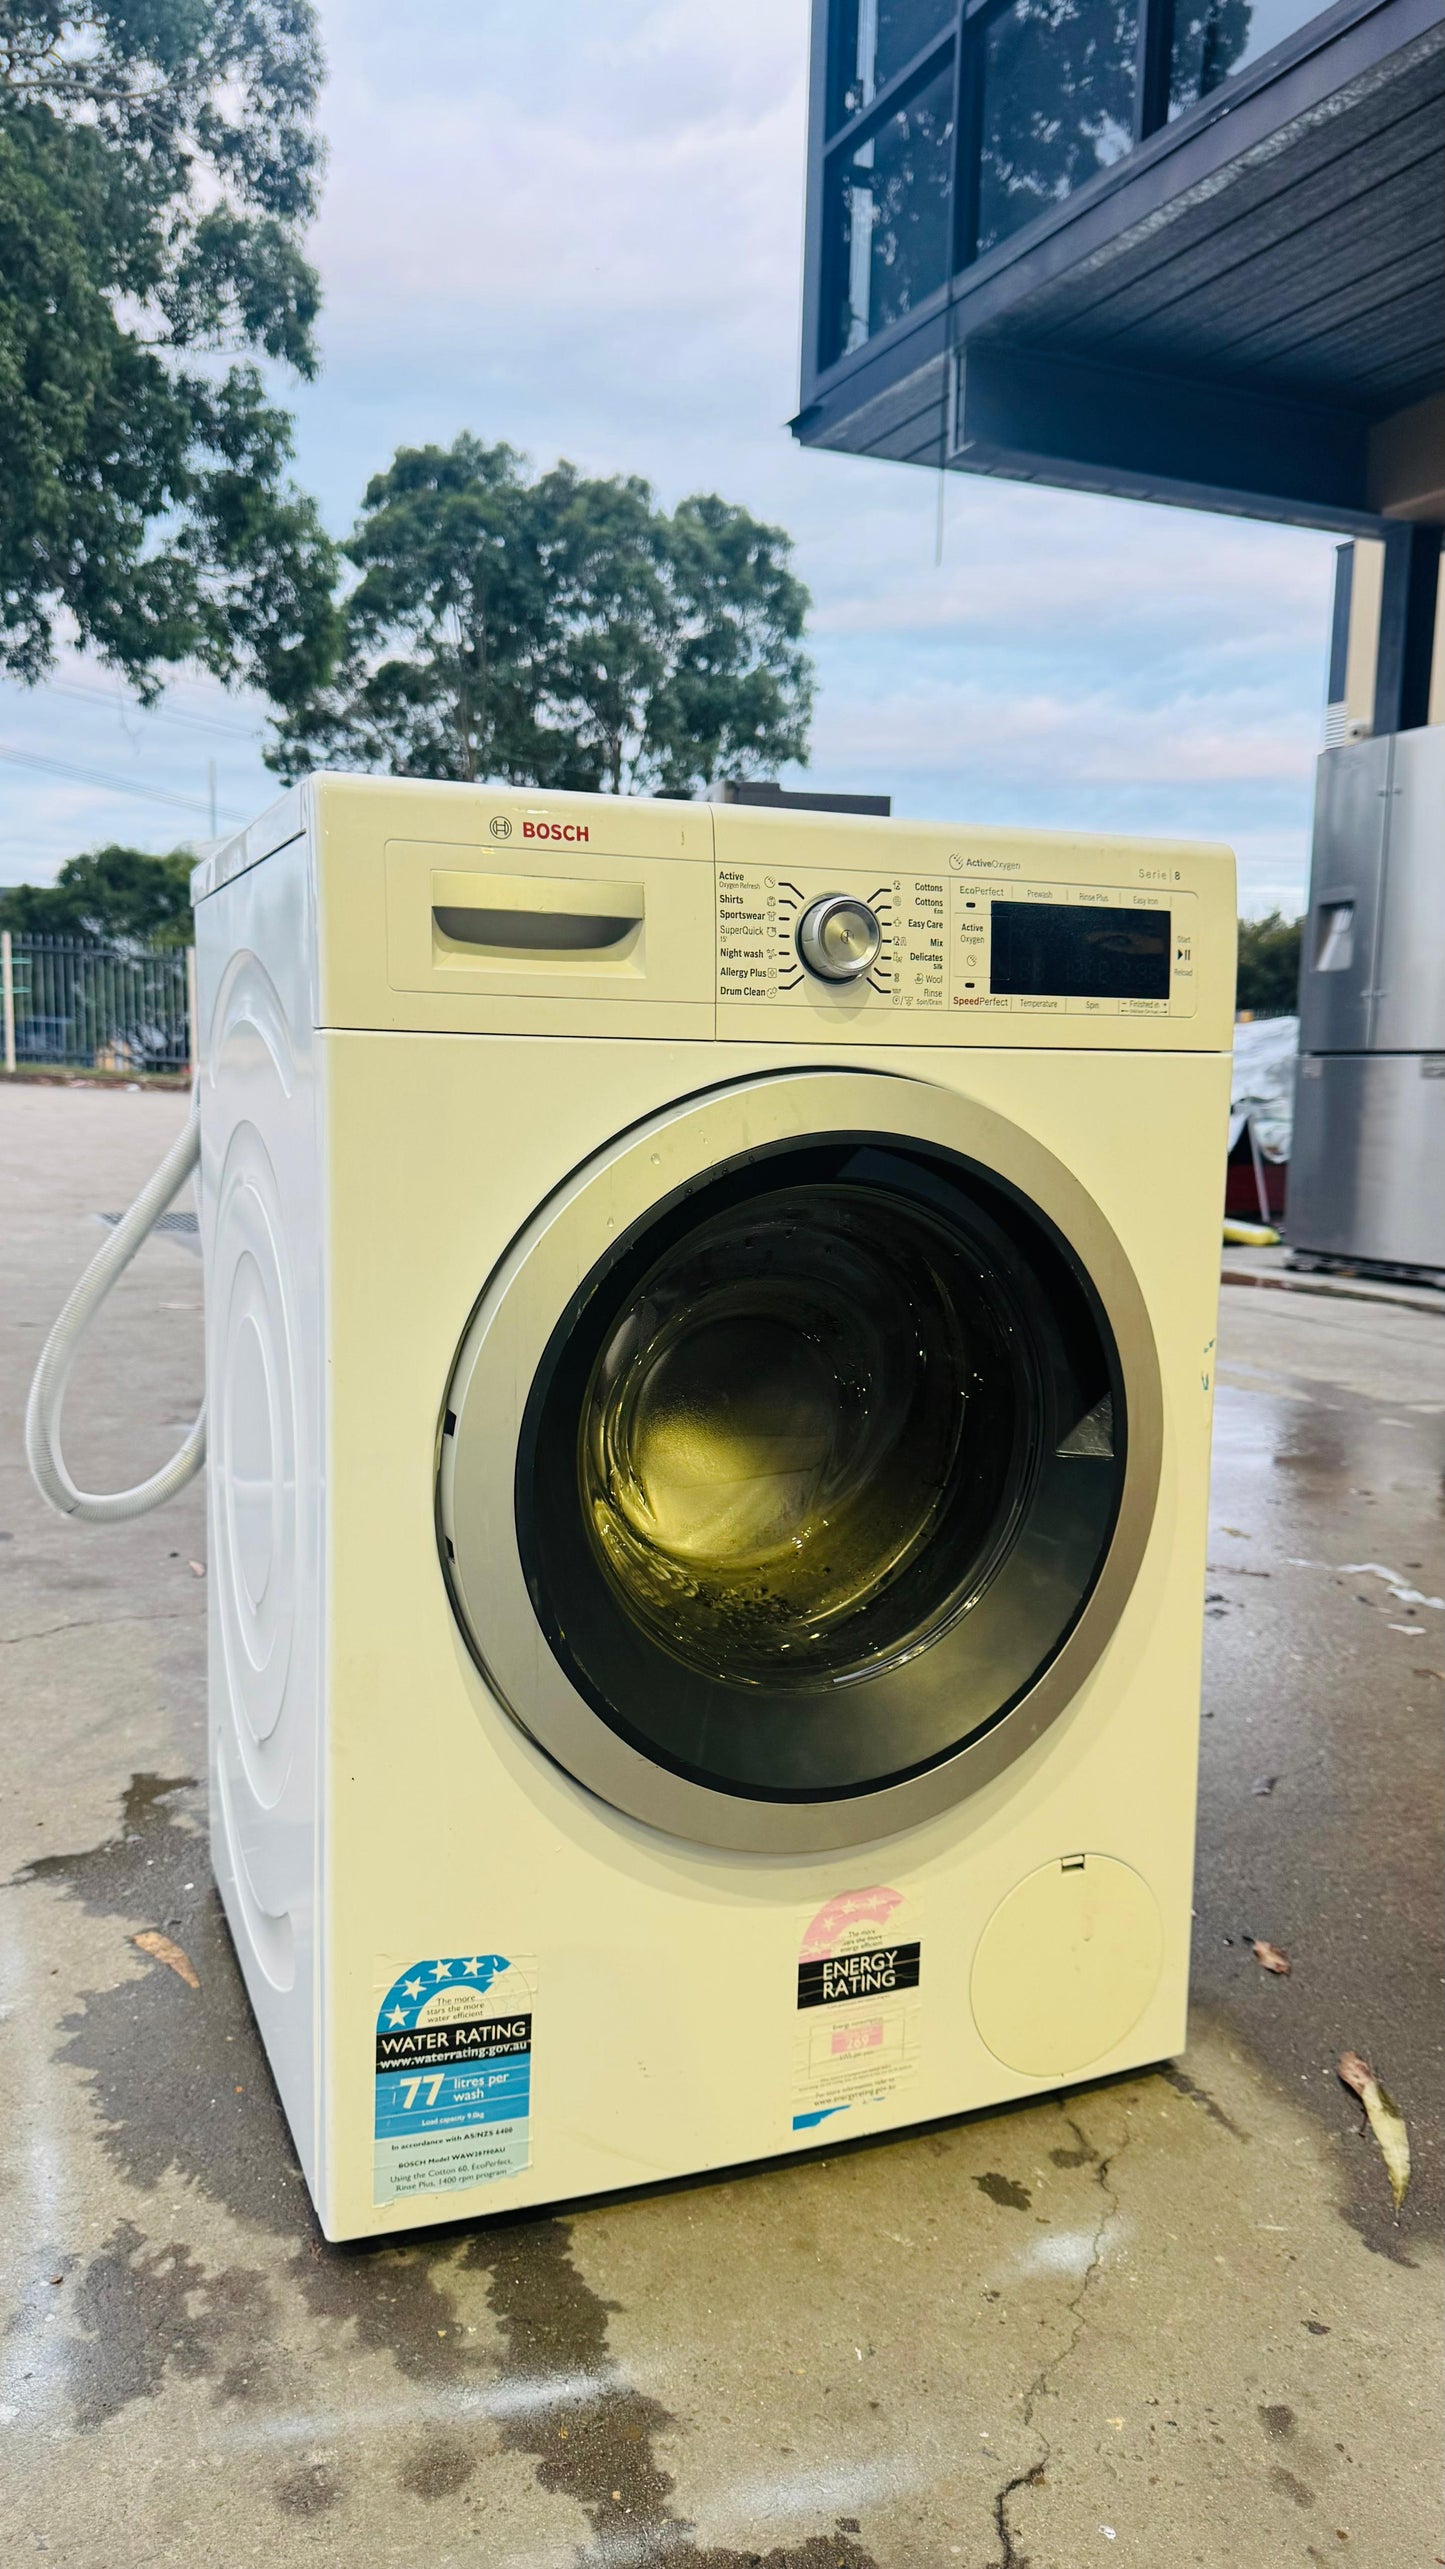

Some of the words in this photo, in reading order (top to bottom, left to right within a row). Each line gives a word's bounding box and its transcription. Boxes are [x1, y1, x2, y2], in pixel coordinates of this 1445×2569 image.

[523, 822, 589, 842] BOSCH
[966, 858, 1021, 871] ActiveOxygen
[719, 871, 745, 881] Active
[1138, 868, 1167, 880] Serie
[719, 881, 739, 890] Oxygen
[740, 882, 760, 890] Refresh
[915, 882, 943, 892] Cottons
[959, 885, 1004, 897] EcoPerfect
[1027, 889, 1053, 899] Prewash
[719, 894, 744, 904] Shirts
[915, 897, 943, 907] Cottons
[720, 909, 765, 920] Sportswear
[908, 919, 925, 929] Easy
[926, 920, 943, 929] Care
[961, 923, 984, 932] Active
[720, 925, 764, 936] SuperQuick
[930, 938, 943, 947] Mix
[960, 934, 985, 944] Oxygen
[720, 948, 741, 959] Night
[744, 949, 764, 958] wash
[910, 952, 943, 962] Delicates
[720, 967, 748, 979] Allergy
[750, 968, 767, 978] Plus
[925, 975, 943, 984] Wool
[720, 986, 741, 996] Drum
[744, 987, 766, 996] Clean
[924, 988, 943, 997] Rinse
[953, 996, 1009, 1007] SpeedPerfect
[1020, 999, 1057, 1009] Temperature
[1086, 1001, 1099, 1010] Spin
[823, 1950, 898, 1981] ENERGY
[823, 1969, 896, 2000] RATING
[437, 1997, 451, 2006] The
[453, 2010, 483, 2019] efficient
[382, 2033, 449, 2055] WATER
[456, 2021, 526, 2045] RATING
[380, 2042, 527, 2069] www.waterrating.gov.au
[454, 2076, 484, 2089] litres
[488, 2073, 509, 2087] per
[400, 2073, 445, 2109] 77
[453, 2088, 484, 2102] wash
[421, 2117, 438, 2126] Load
[401, 2139, 443, 2149] accordance
[398, 2160, 426, 2168] BOSCH
[428, 2156, 450, 2164] Model
[390, 2175, 411, 2184] Using
[413, 2171, 426, 2179] the
[428, 2168, 455, 2176] Cotton
[396, 2184, 416, 2192] Rinse
[439, 2177, 456, 2185] 1400
[459, 2174, 474, 2183] rpm
[476, 2169, 507, 2180] program
